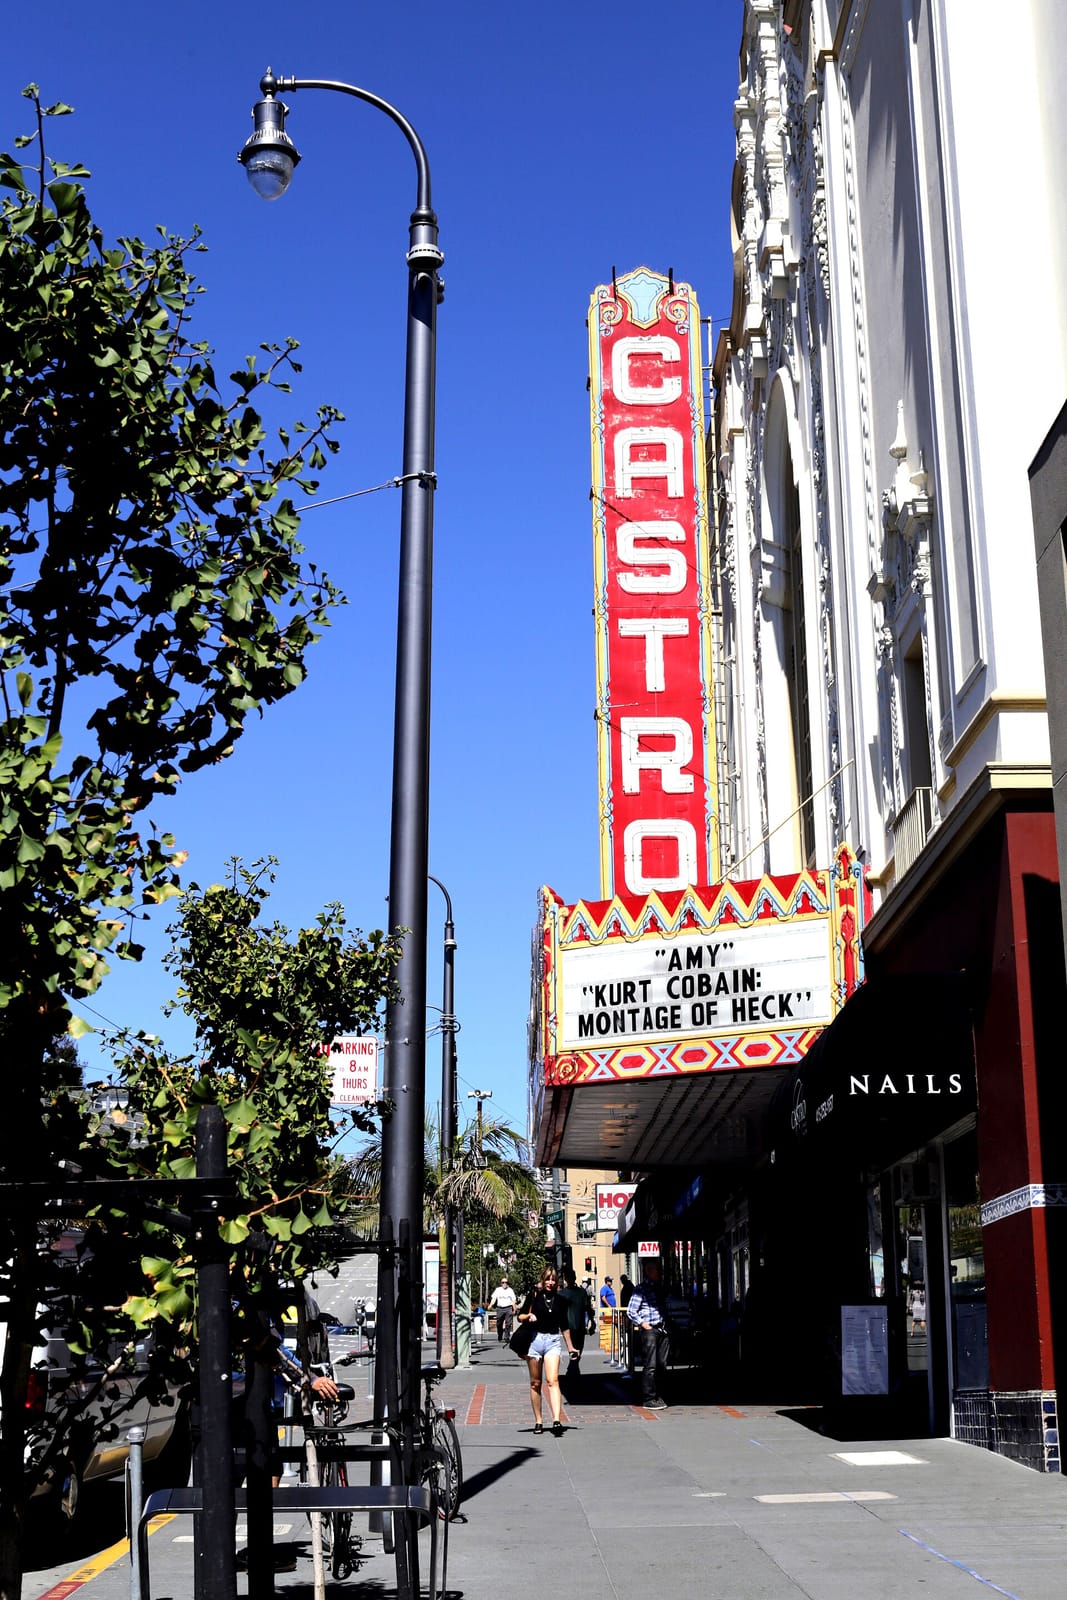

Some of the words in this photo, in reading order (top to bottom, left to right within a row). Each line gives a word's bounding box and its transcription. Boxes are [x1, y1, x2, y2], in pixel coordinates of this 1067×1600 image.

[611, 337, 697, 895] CASTRO
[655, 942, 734, 971] "AMY"
[667, 968, 761, 999] COBAIN:
[578, 1007, 681, 1037] MONTAGE
[692, 1002, 717, 1026] OF
[333, 1042, 374, 1055] ARKING
[350, 1060, 357, 1072] 8
[342, 1078, 368, 1089] THURS
[849, 1074, 962, 1095] NAILS
[640, 1243, 659, 1252] ATM
